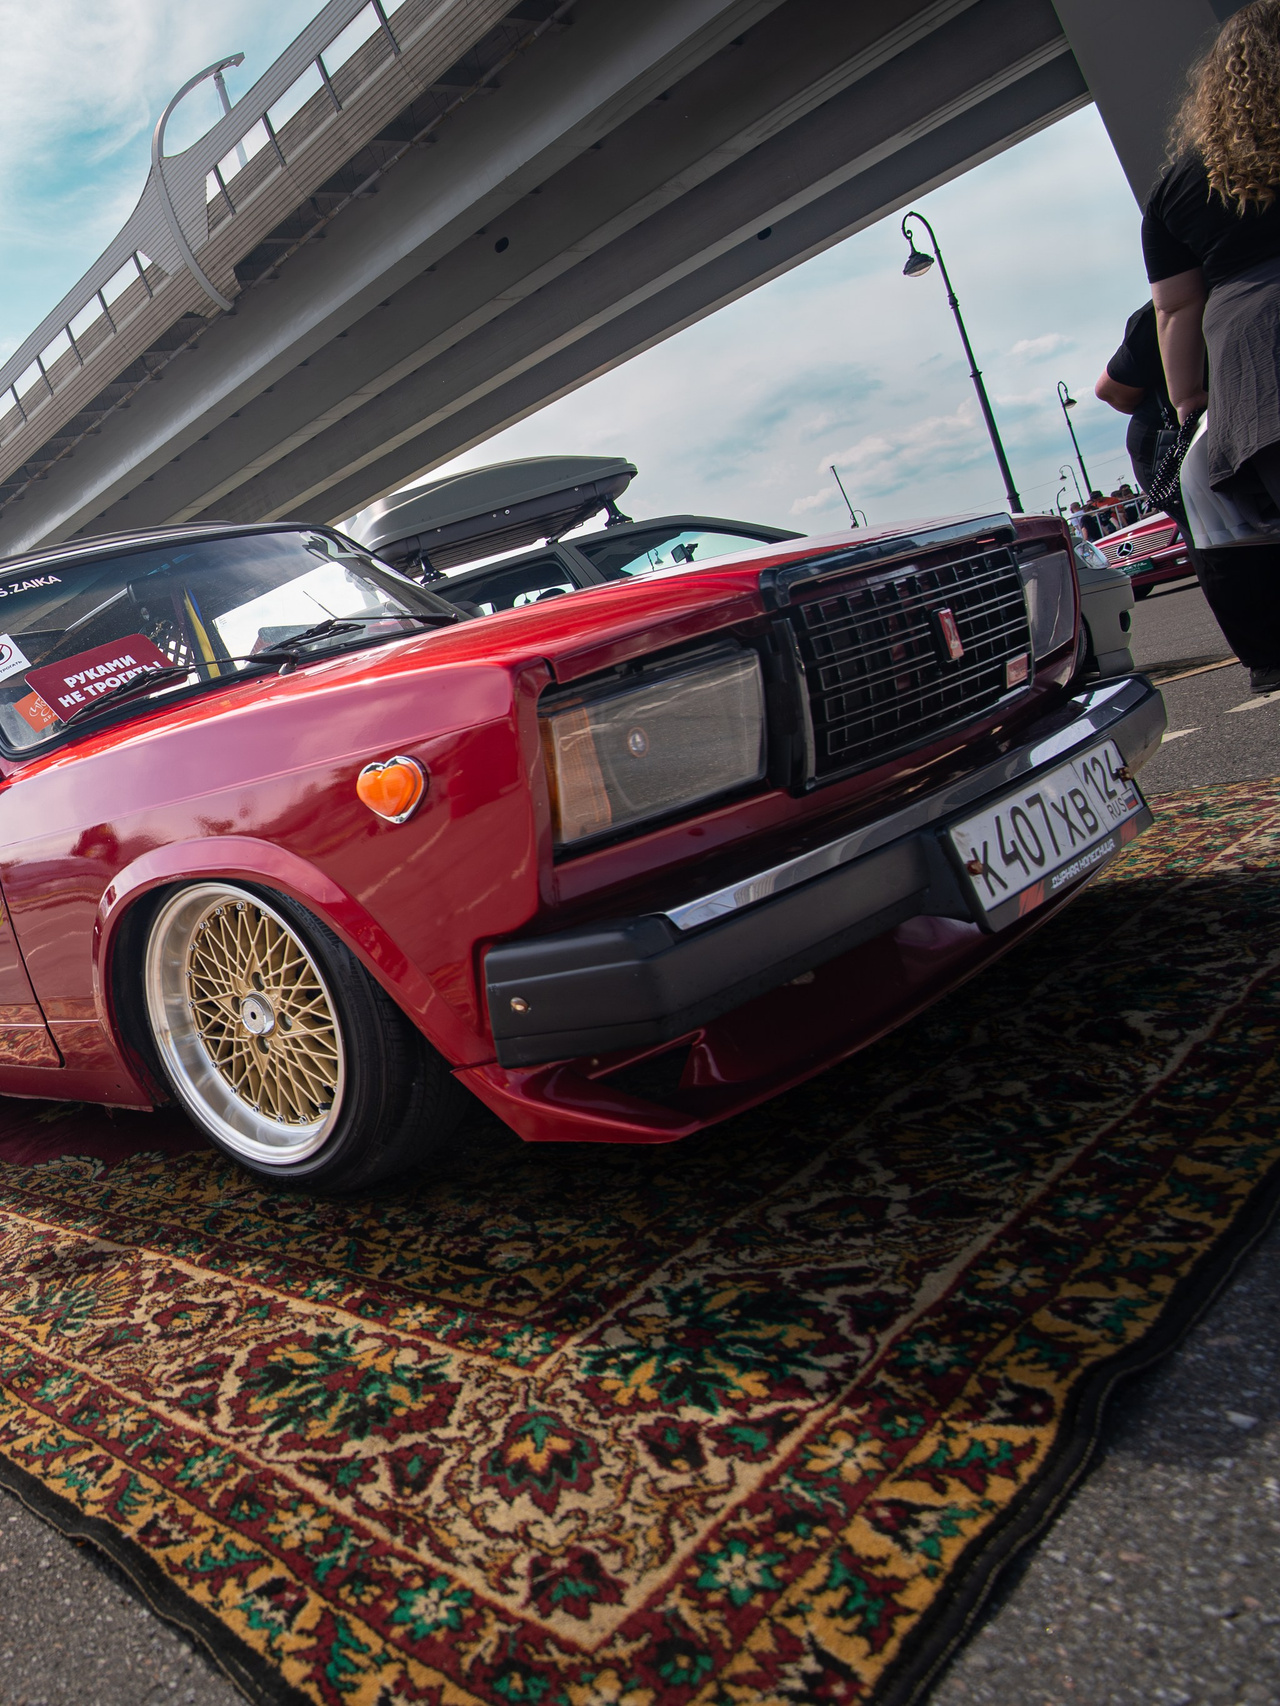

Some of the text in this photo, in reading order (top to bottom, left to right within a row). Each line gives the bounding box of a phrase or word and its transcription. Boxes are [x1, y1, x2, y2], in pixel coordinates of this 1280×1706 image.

[0, 660, 23, 674] ТРОГАТЬ
[63, 654, 138, 688] РУКАМИ
[58, 689, 86, 708] НЕ
[1106, 797, 1128, 820] RUS
